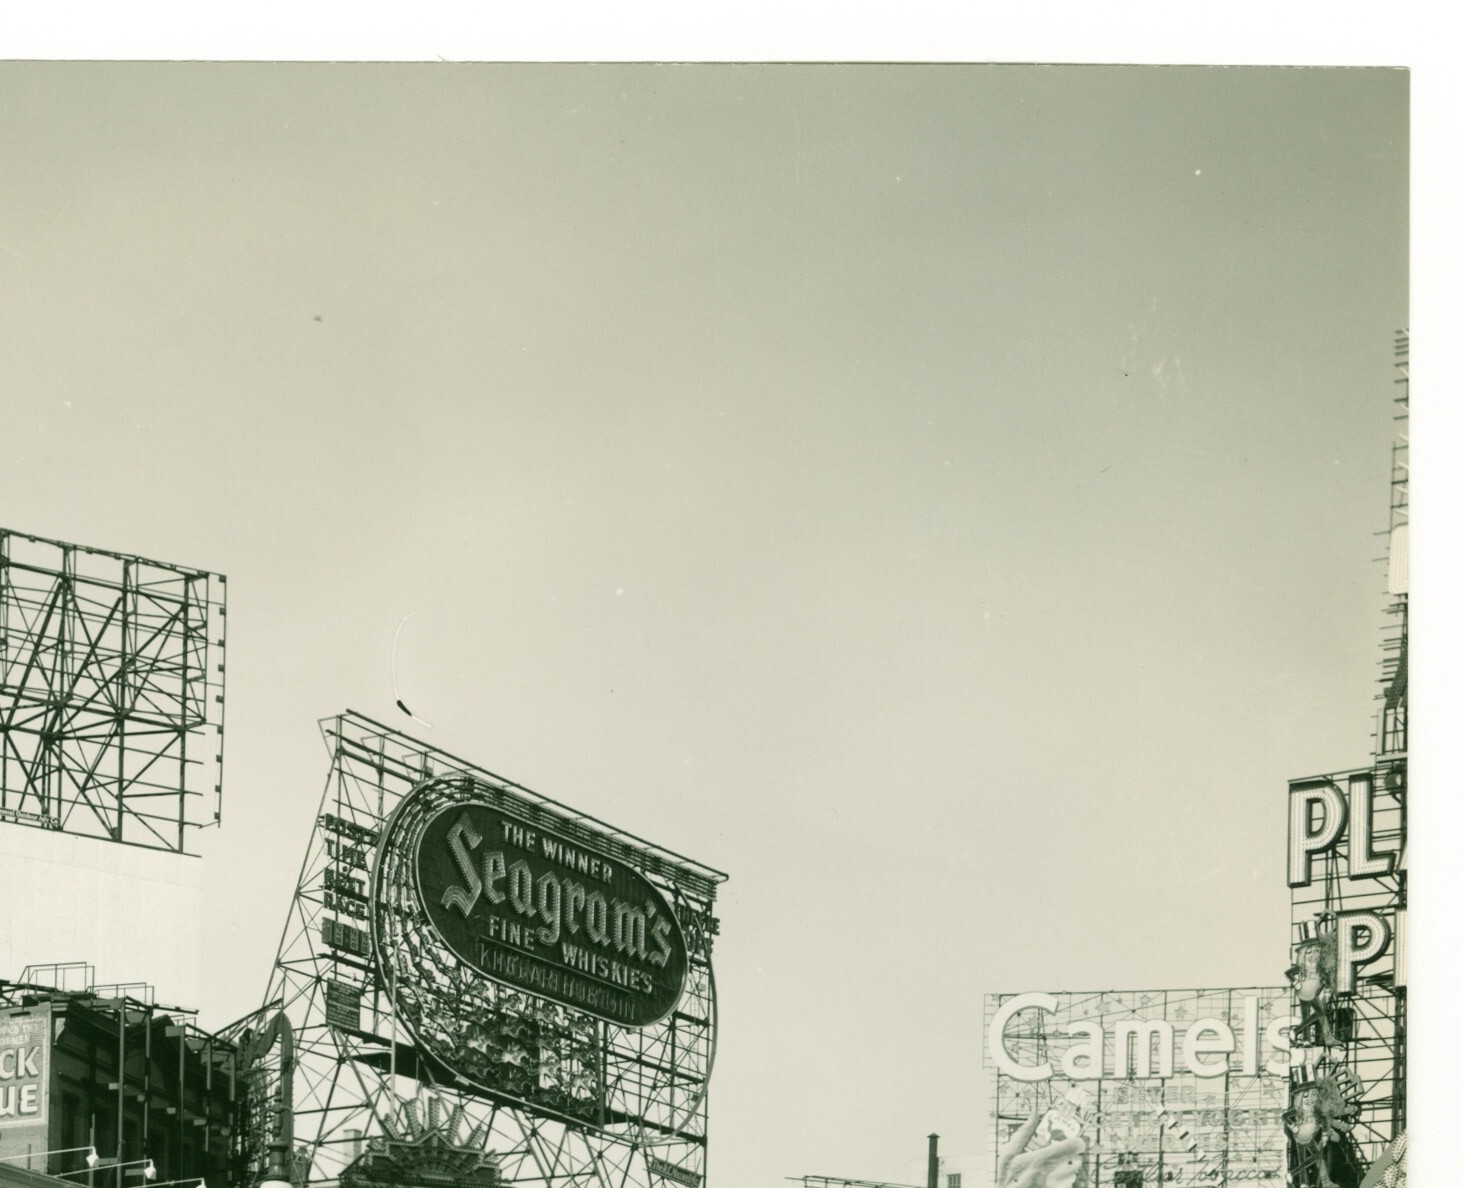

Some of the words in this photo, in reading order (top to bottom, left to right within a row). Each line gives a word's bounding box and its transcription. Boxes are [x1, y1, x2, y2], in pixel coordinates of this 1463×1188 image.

[501, 819, 536, 853] THE
[540, 836, 614, 887] WINNER
[1286, 772, 1407, 888] PL
[440, 810, 672, 969] Seagram's
[488, 915, 536, 952] FINE
[561, 940, 653, 994] WHISKIES
[988, 991, 1305, 1082] Camels
